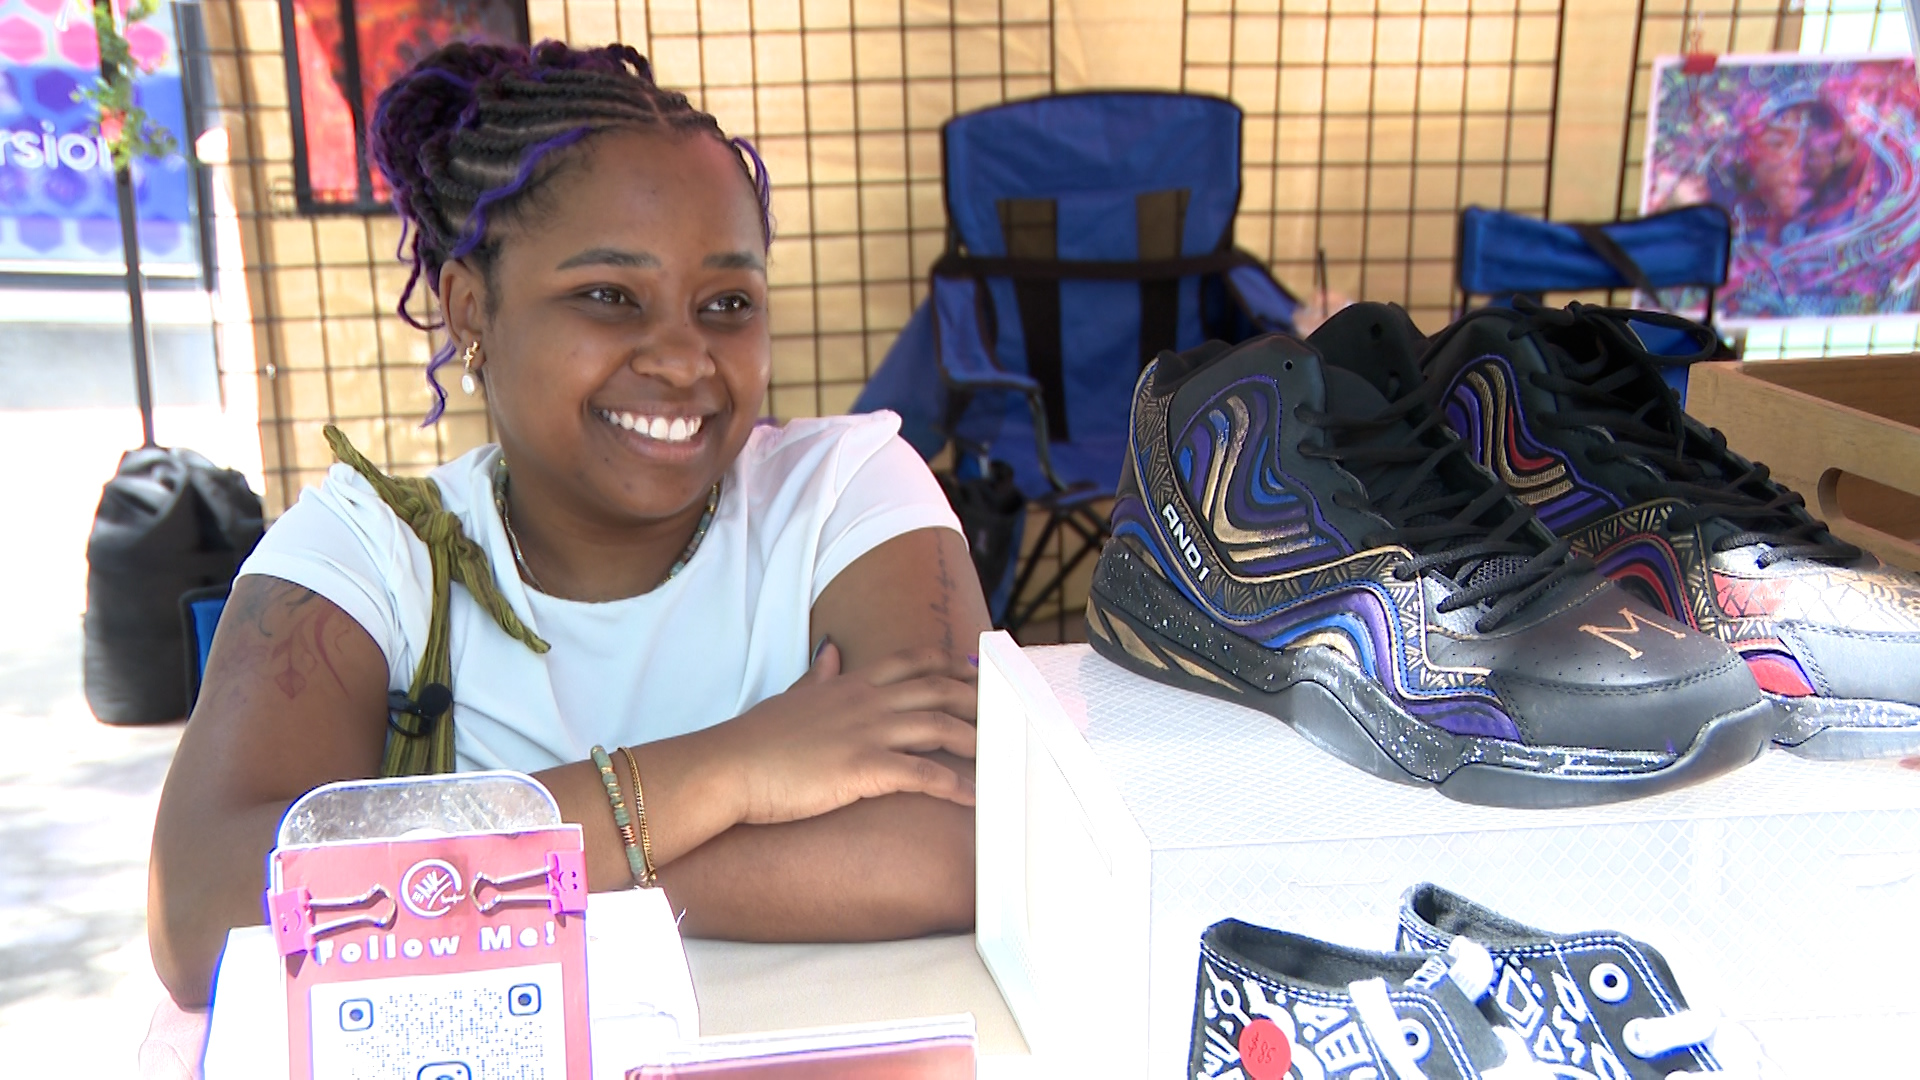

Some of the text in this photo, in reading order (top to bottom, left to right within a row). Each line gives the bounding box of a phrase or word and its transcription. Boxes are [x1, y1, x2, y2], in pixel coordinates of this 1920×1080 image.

[1578, 607, 1686, 661] M
[316, 921, 556, 965] Follow Me!
